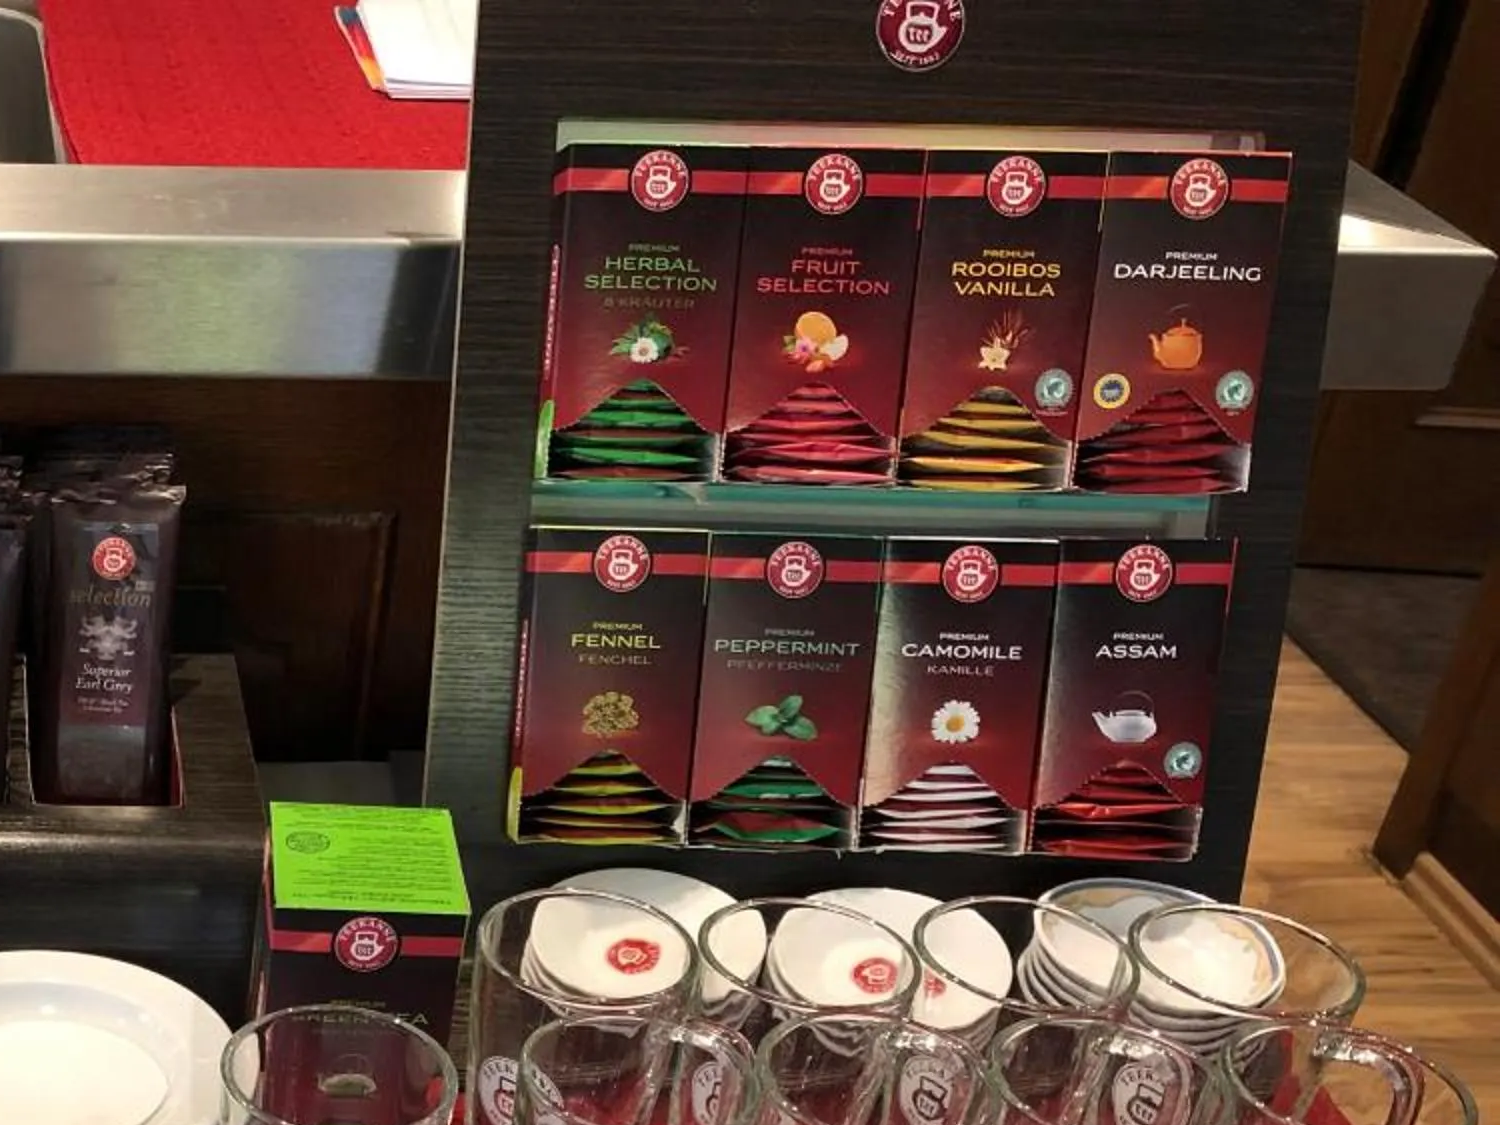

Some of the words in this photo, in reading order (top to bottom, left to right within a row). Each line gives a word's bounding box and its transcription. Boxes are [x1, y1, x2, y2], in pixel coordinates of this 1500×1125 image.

[628, 243, 680, 253] PREMIUM
[802, 247, 853, 256] PREMIUM
[983, 249, 1035, 258] PREMIUM
[605, 256, 700, 273] HERBAL
[1165, 252, 1218, 261] PREMIUM
[791, 259, 861, 275] FRUIT
[951, 262, 1061, 279] ROOIBOS
[1114, 263, 1262, 282] DARJEELING
[584, 274, 717, 292] SELECTION
[756, 277, 890, 295] SELECTION
[953, 280, 1056, 297] VANILLA
[593, 622, 643, 630] PREMIUM
[764, 628, 815, 637] PREMIUM
[571, 632, 661, 650] FENNEL
[939, 632, 990, 641] PREMIUM
[1113, 632, 1164, 641] PREMIUM
[714, 639, 861, 656] PEPPERMINT
[901, 643, 1022, 661] CAMOMILE
[1095, 644, 1178, 660] ASSAM
[578, 654, 652, 666] FENCHEL
[927, 664, 994, 677] KAMILLE
[75, 677, 101, 691] Earl
[103, 679, 134, 694] Grey
